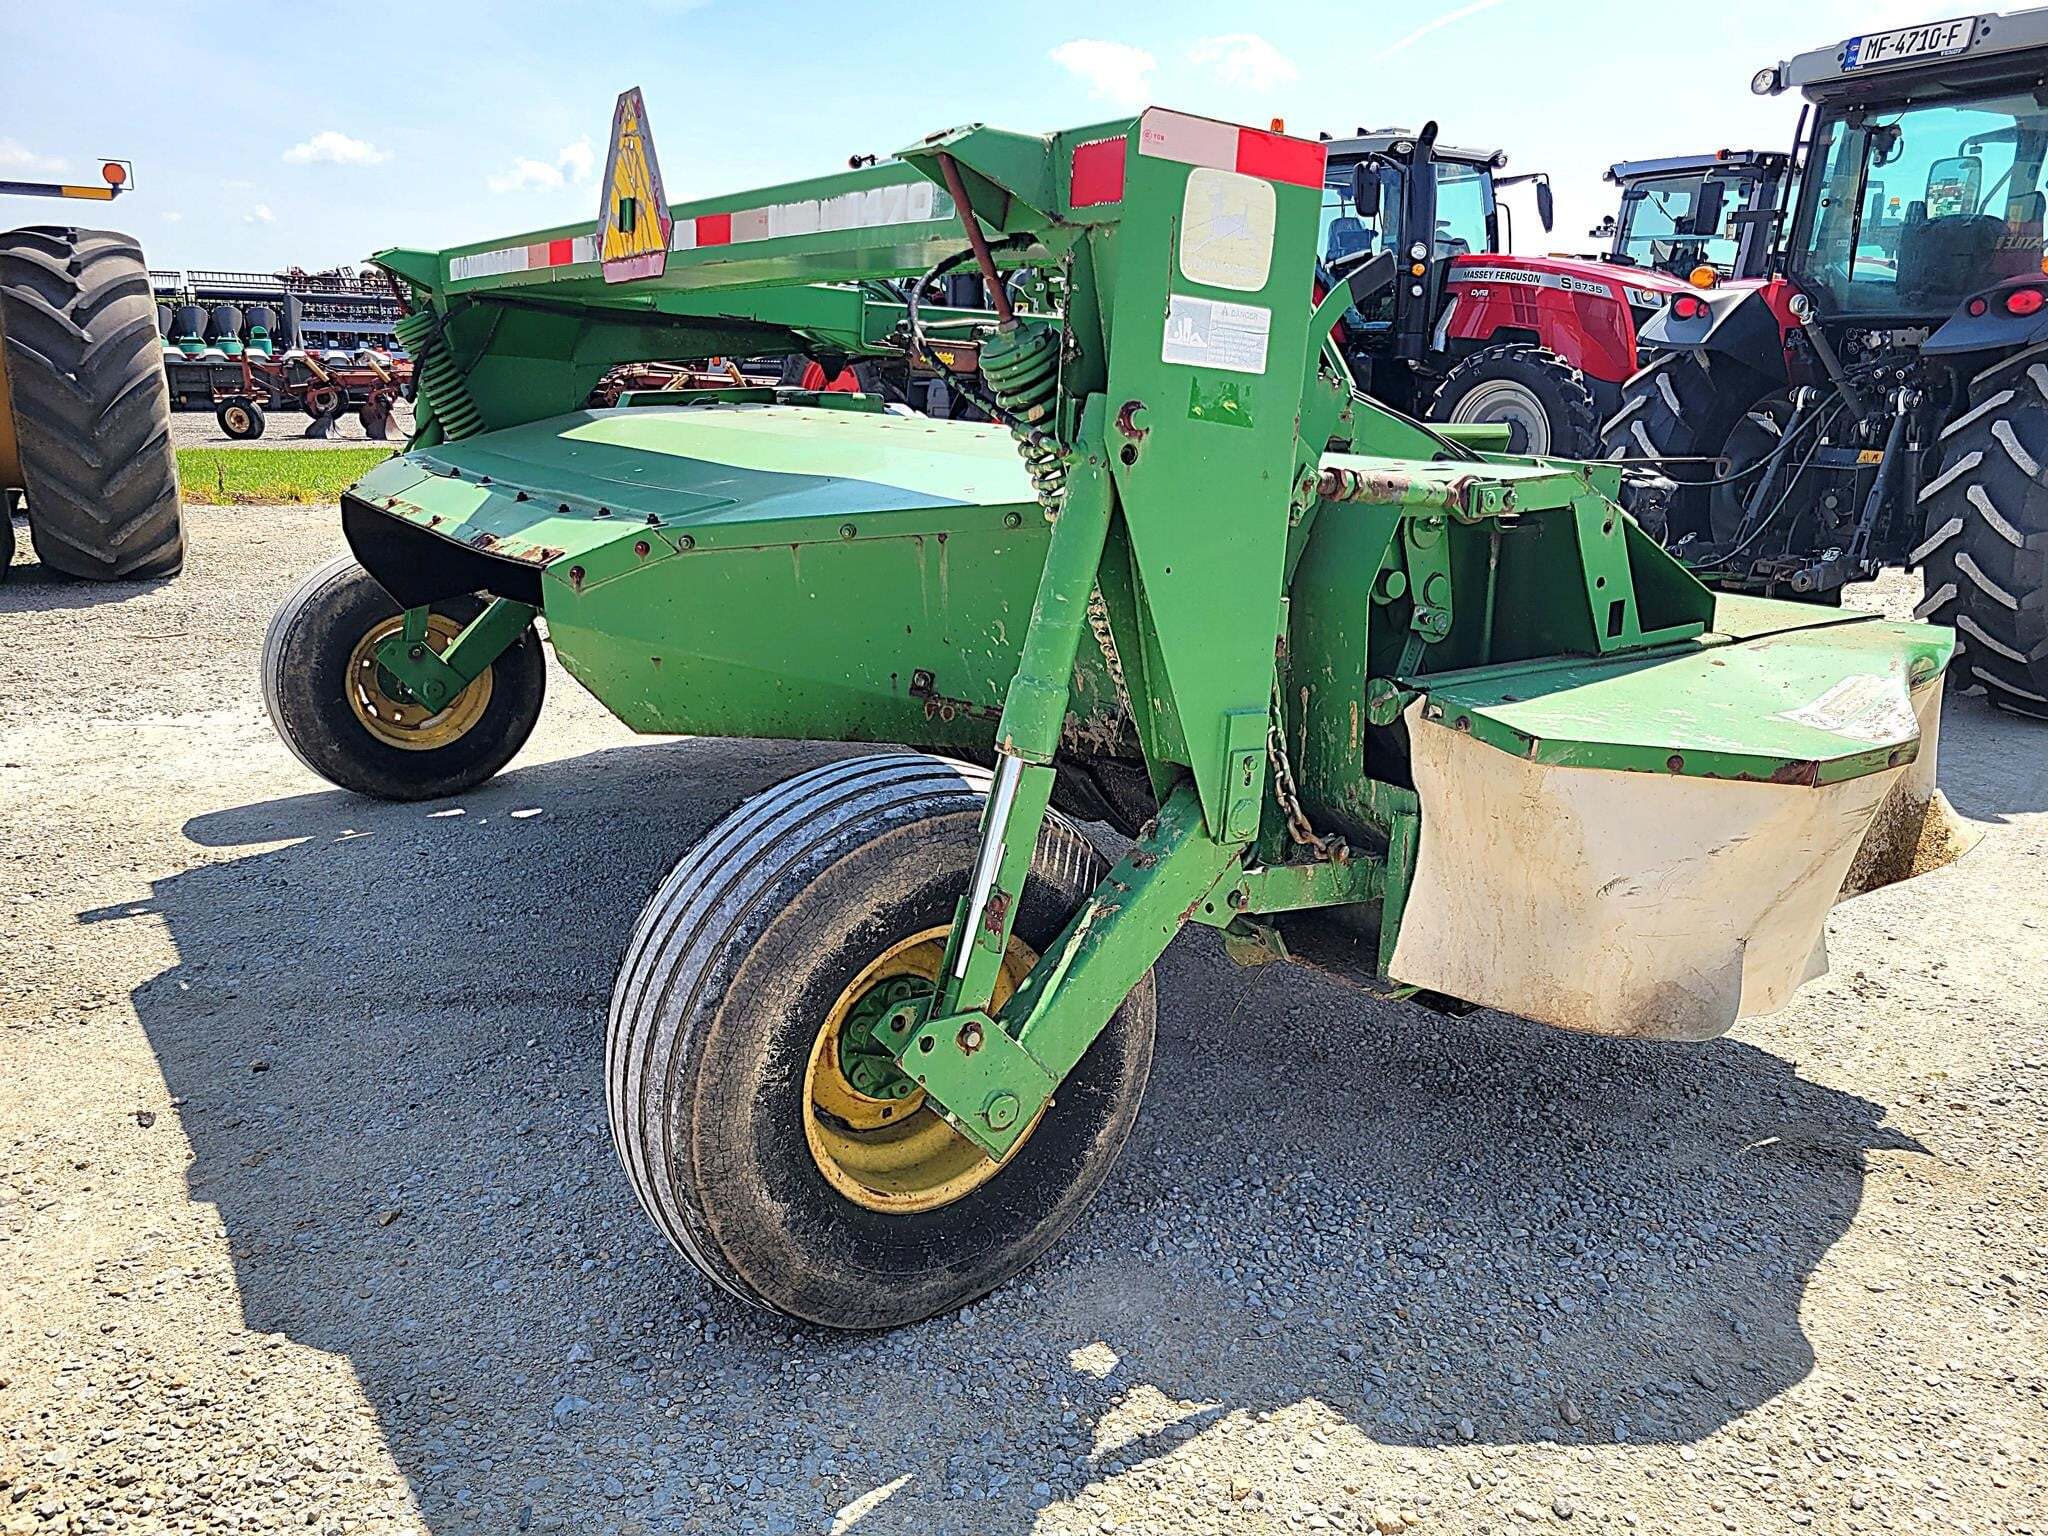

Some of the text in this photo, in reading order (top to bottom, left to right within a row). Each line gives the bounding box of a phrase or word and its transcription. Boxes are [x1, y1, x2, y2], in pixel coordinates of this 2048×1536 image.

[1864, 24, 1963, 61] MF-4710-F
[1463, 270, 1541, 283] MASSEY FERGUSON
[1560, 277, 1603, 294] S 8735
